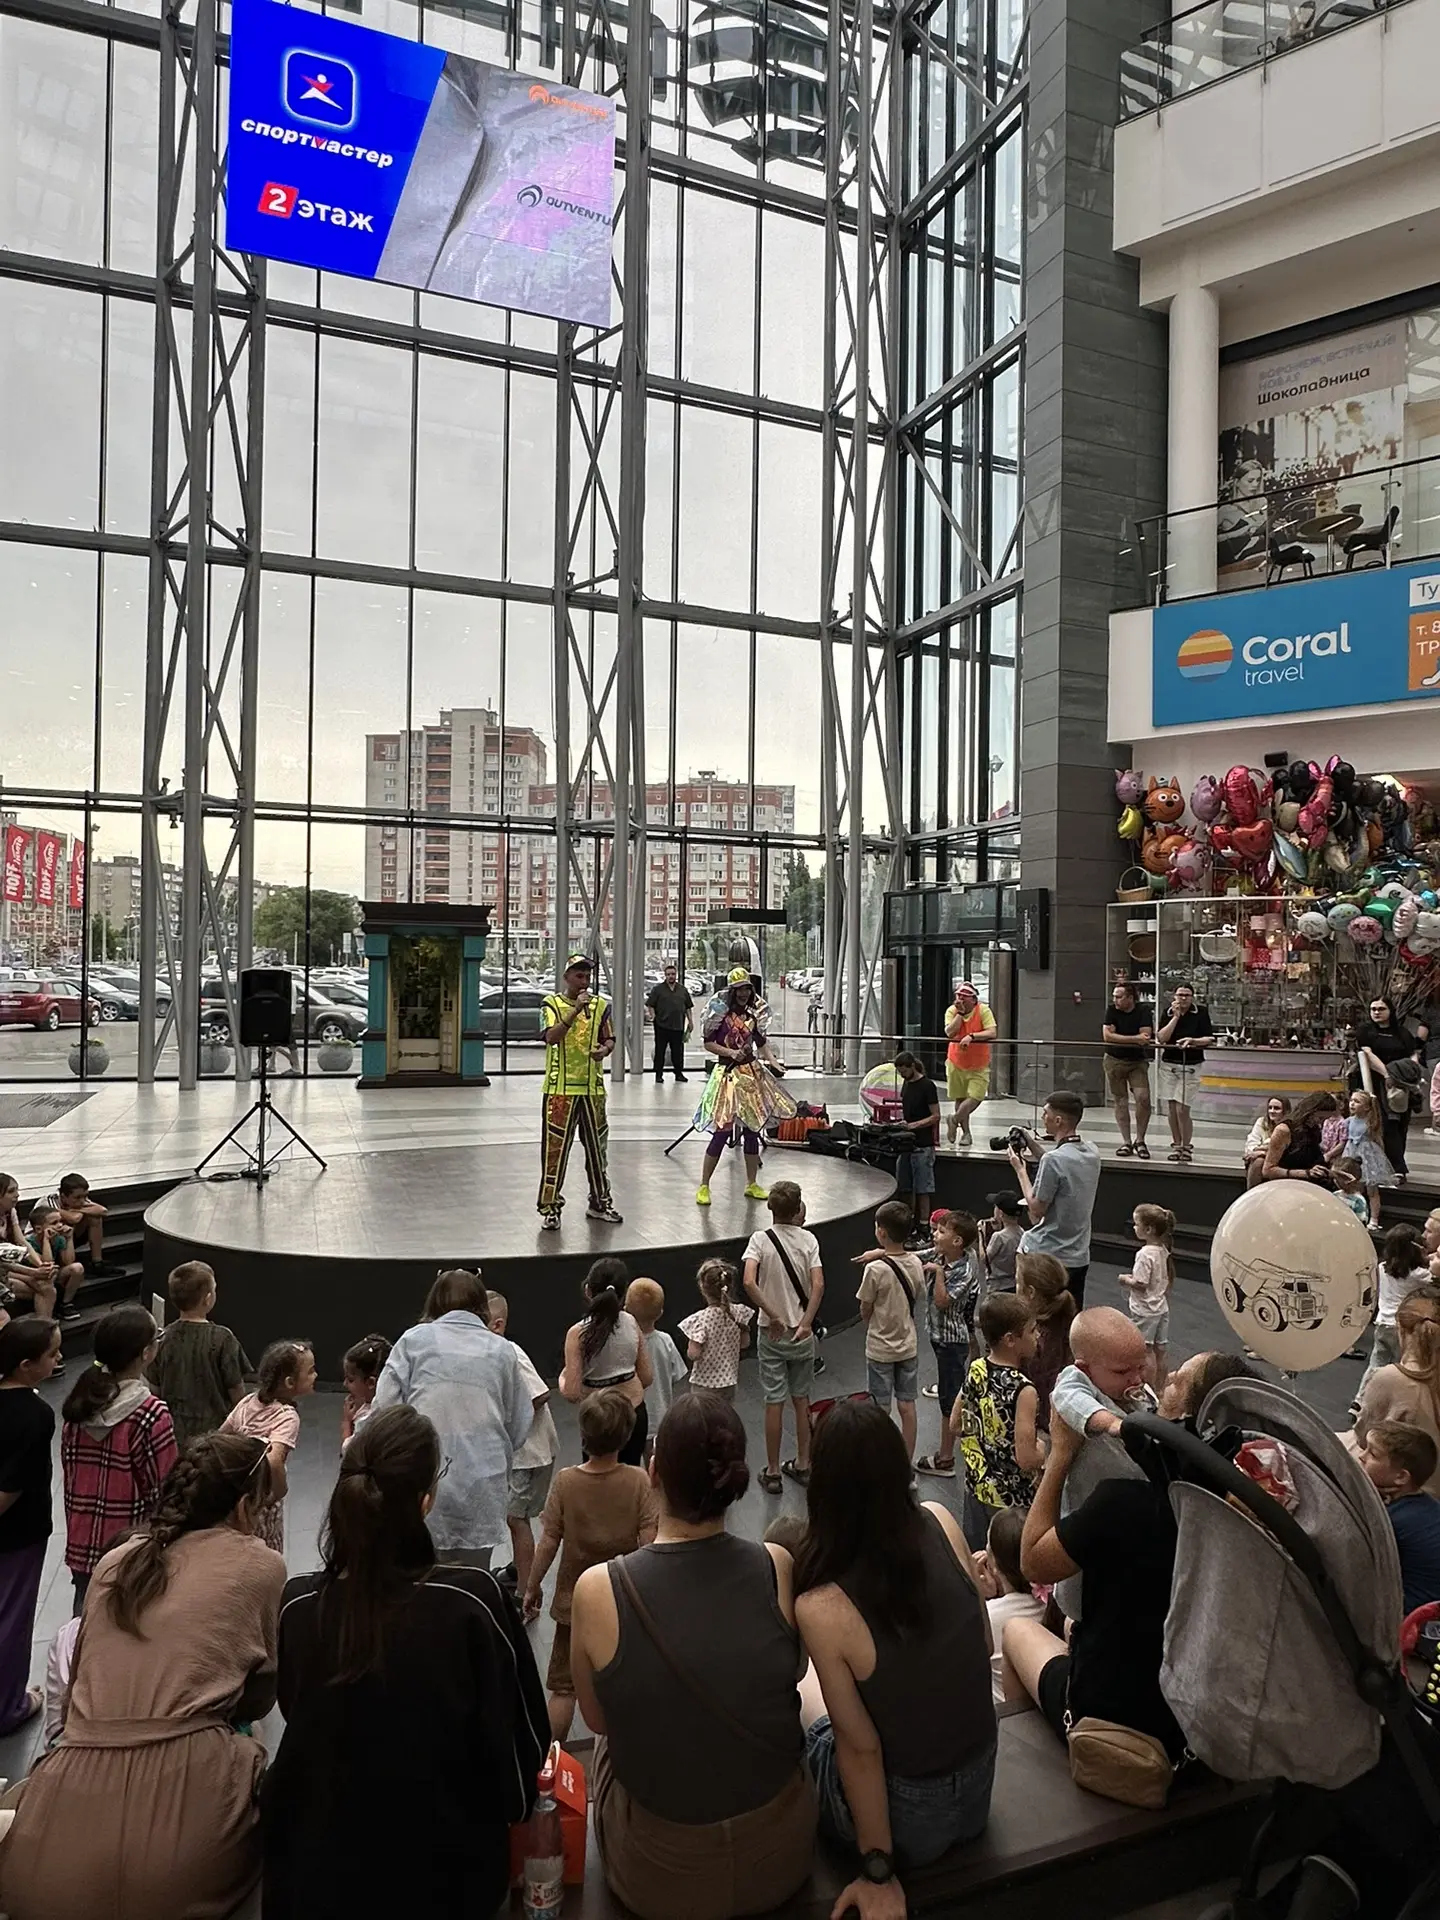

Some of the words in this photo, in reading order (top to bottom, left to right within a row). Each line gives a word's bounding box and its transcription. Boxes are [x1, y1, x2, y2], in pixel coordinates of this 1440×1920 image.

[241, 119, 393, 168] спортмастер
[268, 188, 287, 213] 2
[297, 200, 374, 233] этаж
[1257, 367, 1370, 405] Шоколадница
[1242, 622, 1351, 665] Coral
[1245, 663, 1304, 687] travel
